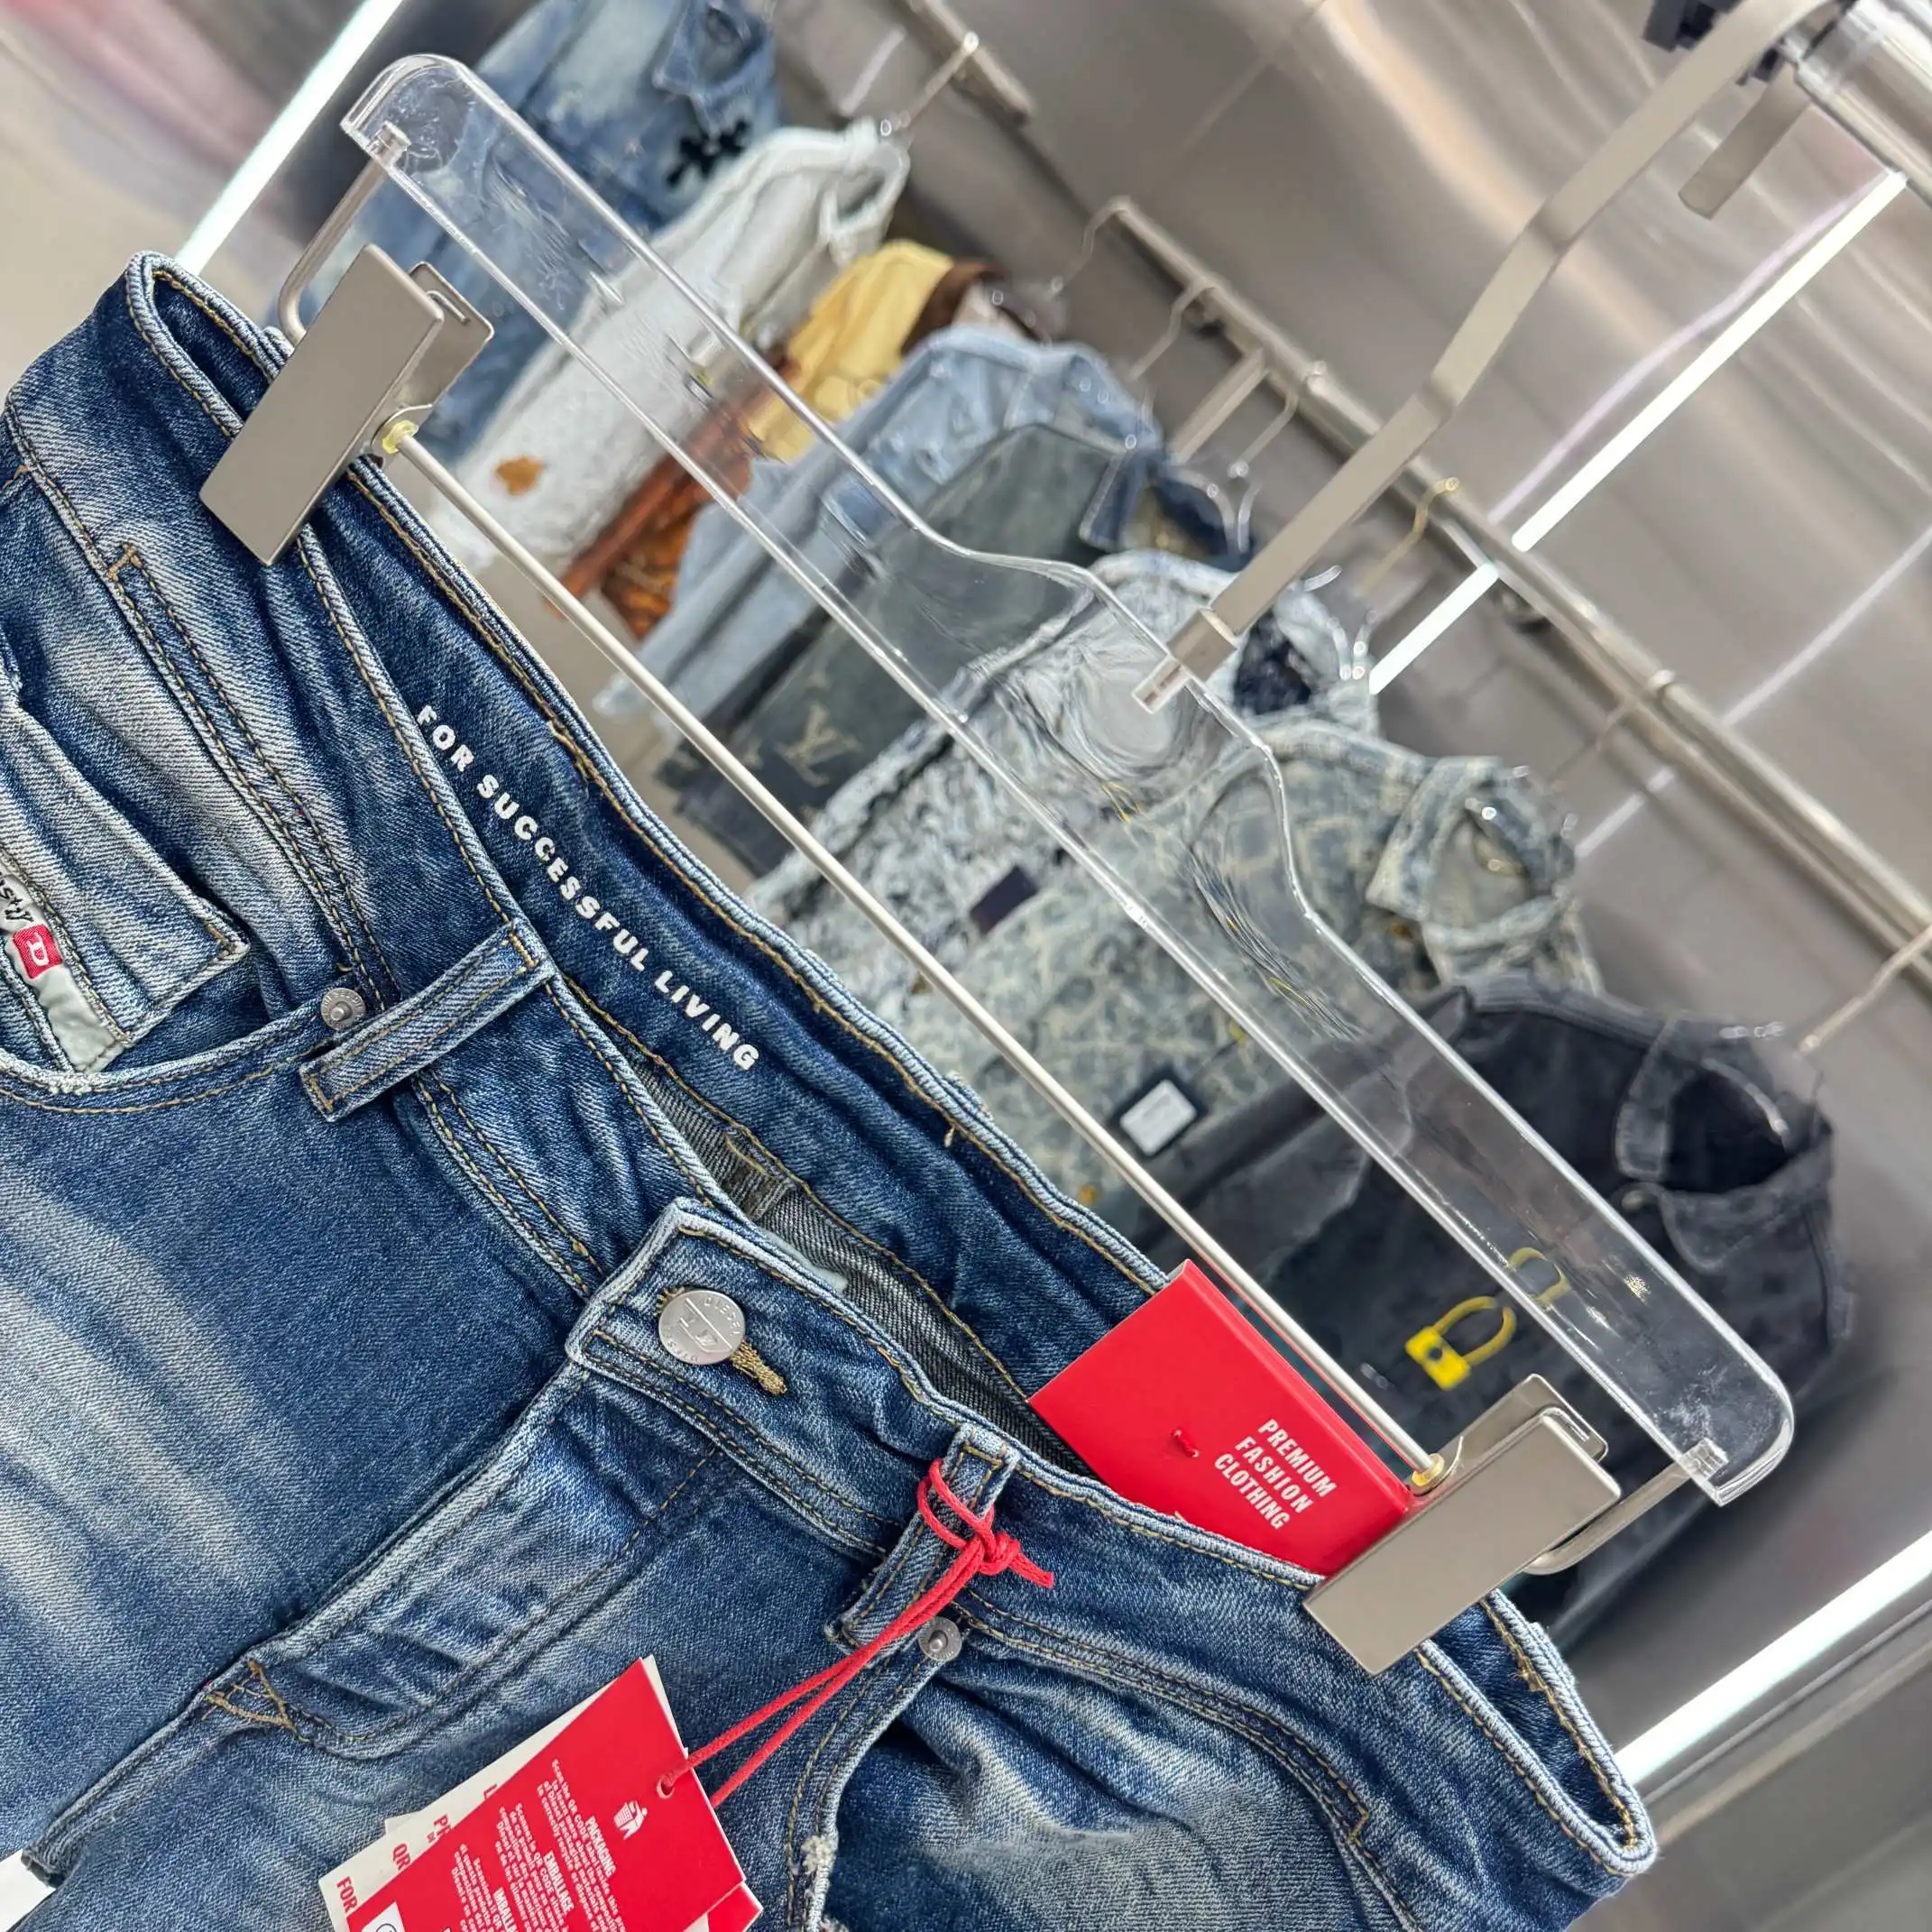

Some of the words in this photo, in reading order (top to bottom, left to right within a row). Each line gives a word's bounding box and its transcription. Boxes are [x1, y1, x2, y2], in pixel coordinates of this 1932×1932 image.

[417, 705, 474, 772] FOR
[476, 775, 648, 971] SUCCESSFUL
[654, 971, 759, 1071] LIVING
[1235, 1437, 1313, 1513] FASHION
[1258, 1419, 1337, 1497] PREMIUM
[1215, 1453, 1290, 1529] CLOTHING
[568, 1799, 577, 1815] QR
[575, 1815, 589, 1841] CODE
[585, 1817, 616, 1877] PACKAGING
[336, 1876, 358, 1913] FOR
[540, 1868, 554, 1895] CODE
[543, 1851, 574, 1915] EMBALLAGE
